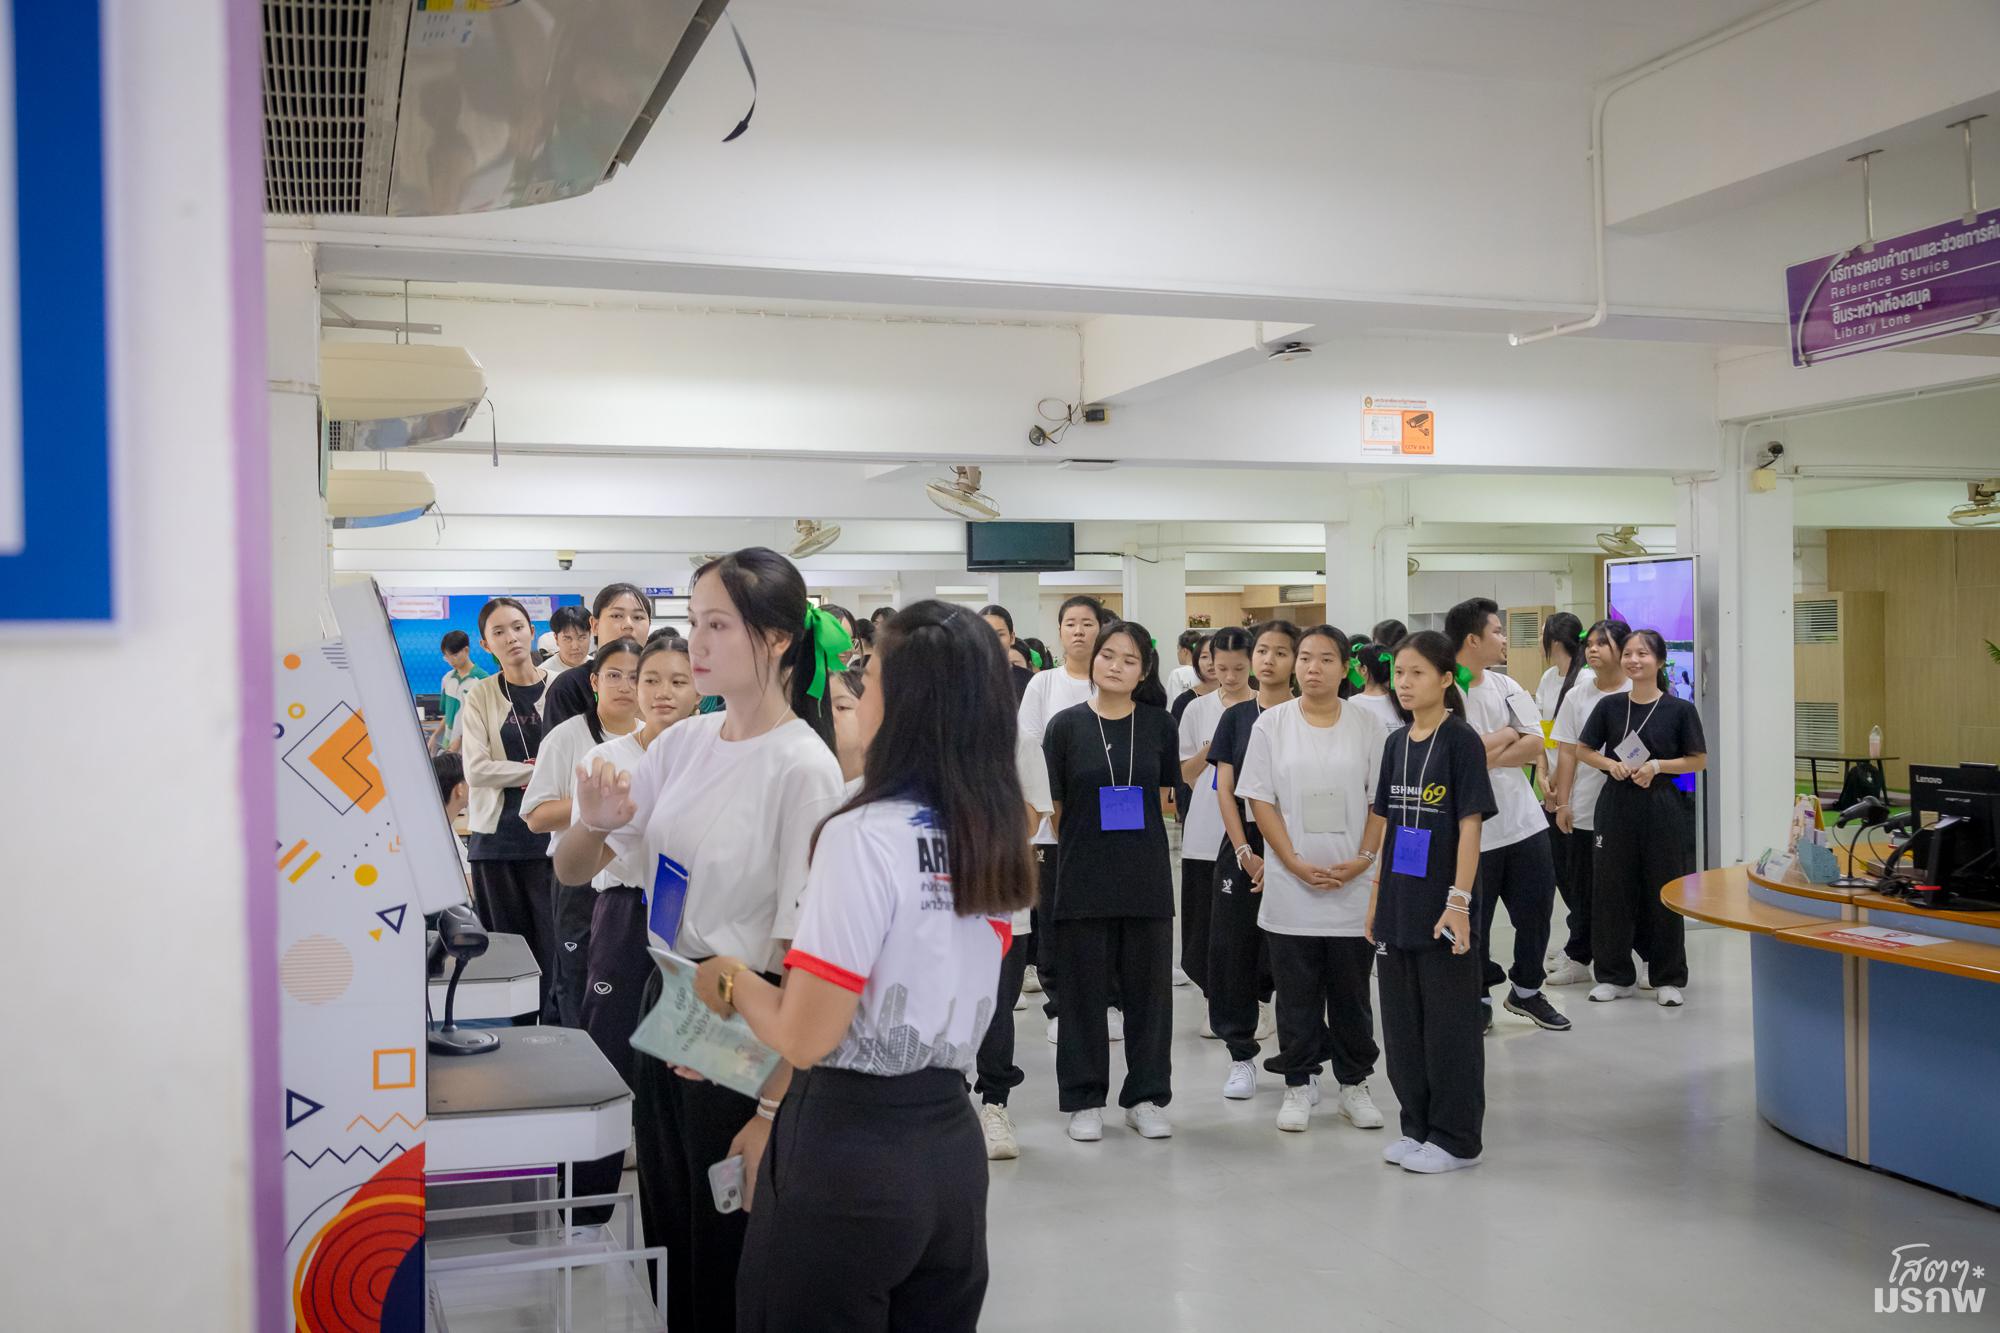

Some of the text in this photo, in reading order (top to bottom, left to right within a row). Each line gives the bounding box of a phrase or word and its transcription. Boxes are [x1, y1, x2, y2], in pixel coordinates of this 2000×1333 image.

[1831, 258, 1950, 299] Reference Service
[1834, 312, 1911, 340] Library Lone
[504, 712, 540, 725] evi
[1915, 774, 1943, 785] Lenovo
[1422, 782, 1447, 805] 69
[917, 837, 948, 873] AR
